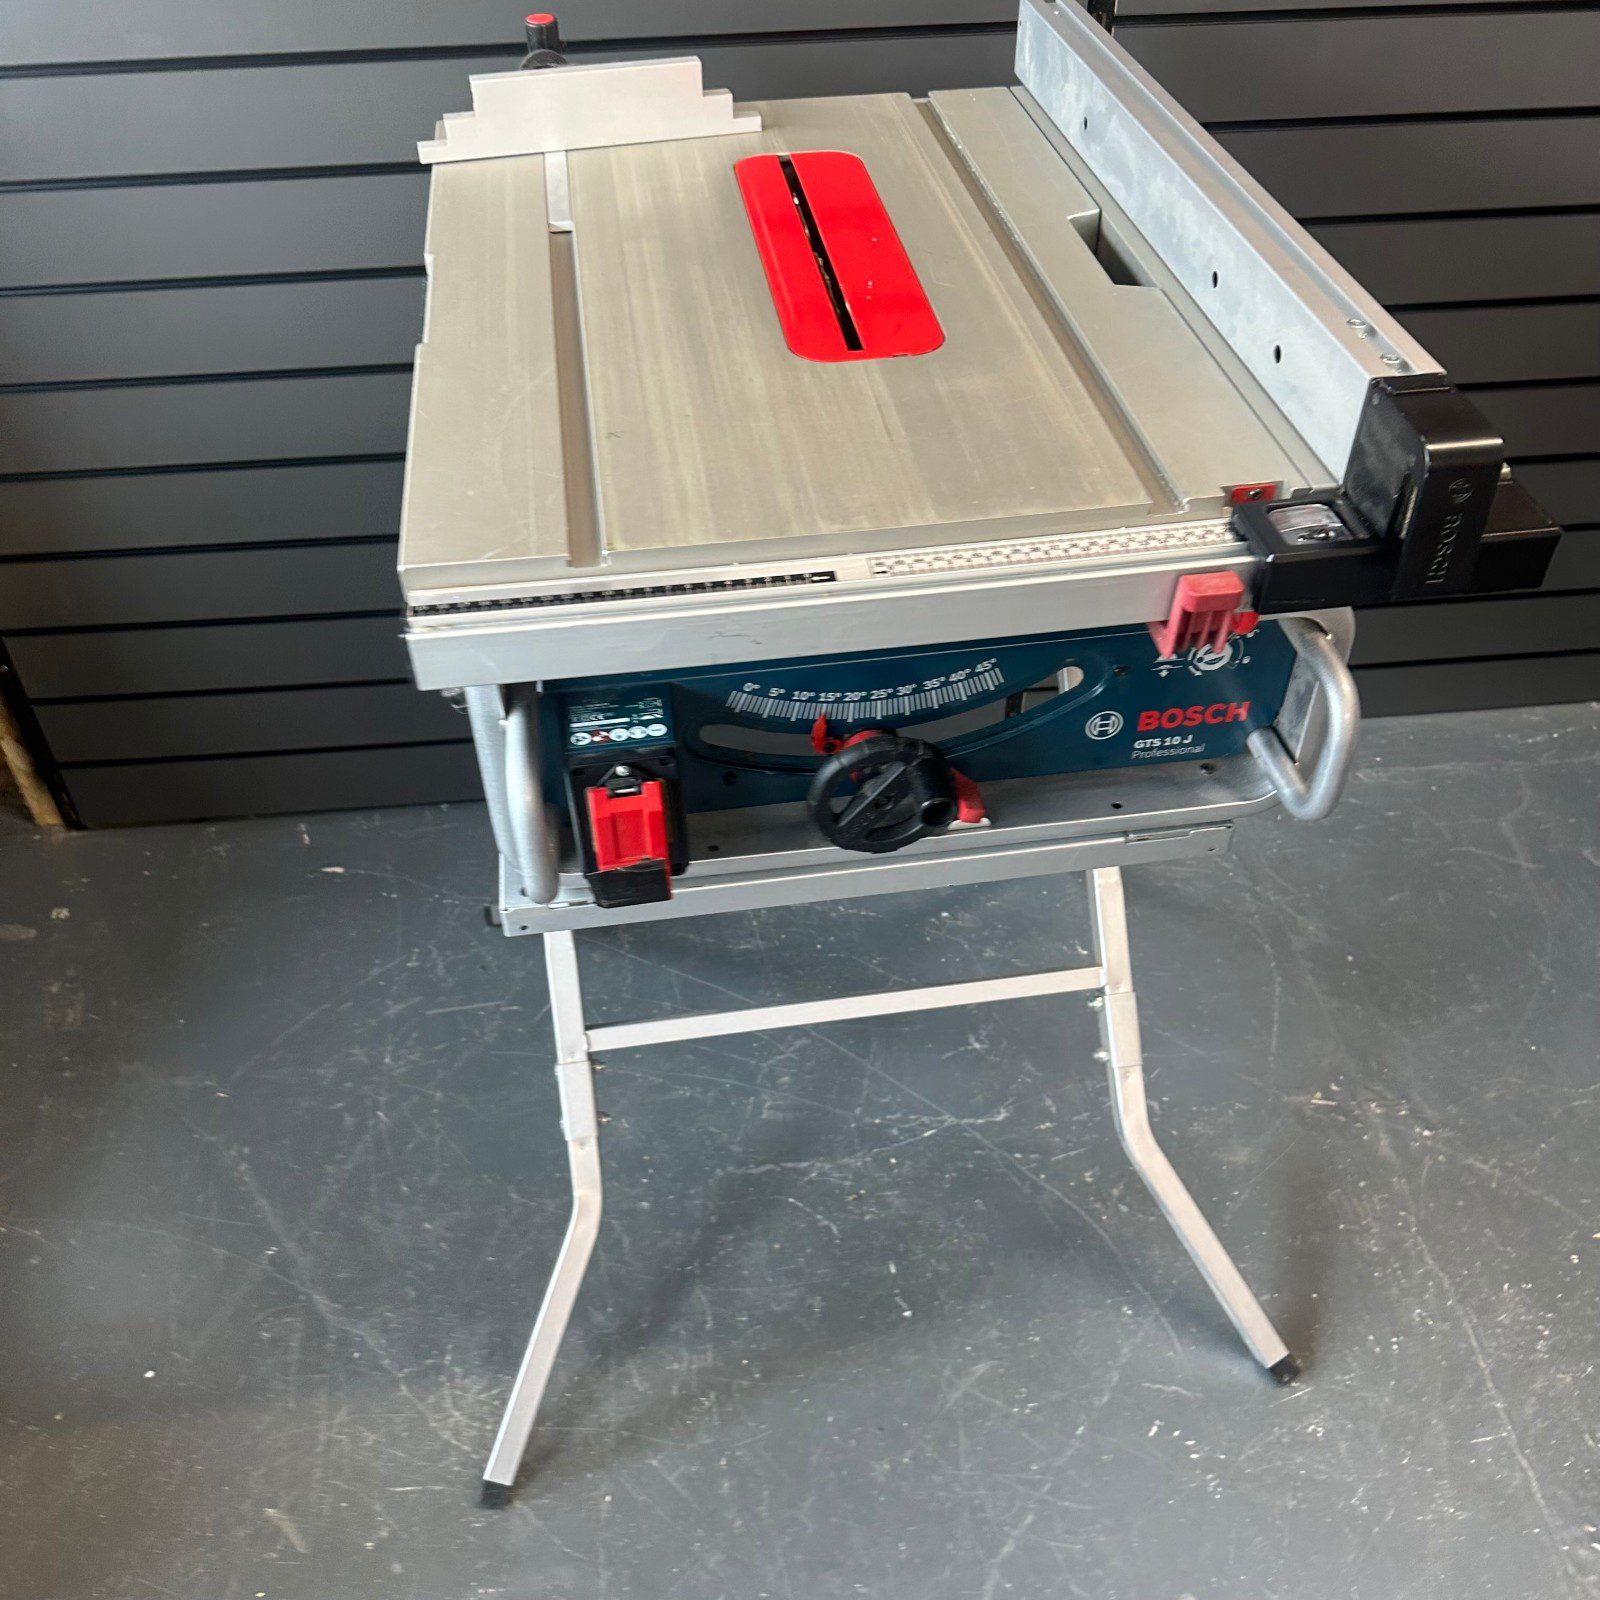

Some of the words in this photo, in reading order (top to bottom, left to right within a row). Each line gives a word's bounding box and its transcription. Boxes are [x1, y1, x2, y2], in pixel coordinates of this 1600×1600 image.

[743, 682, 761, 692] 0°
[768, 687, 786, 697] 5°
[791, 690, 816, 700] 10°
[818, 692, 842, 701] 15°
[843, 691, 868, 701] 20°
[869, 688, 894, 700] 25°
[896, 684, 917, 695] 30°
[923, 677, 946, 690] 35°
[949, 669, 972, 682] 40°
[975, 658, 997, 672] 45°
[1138, 701, 1250, 731] BOSCH
[1132, 744, 1205, 759] Professional
[1134, 738, 1161, 748] GTS
[1163, 735, 1182, 746] 10
[1183, 734, 1193, 744] J
